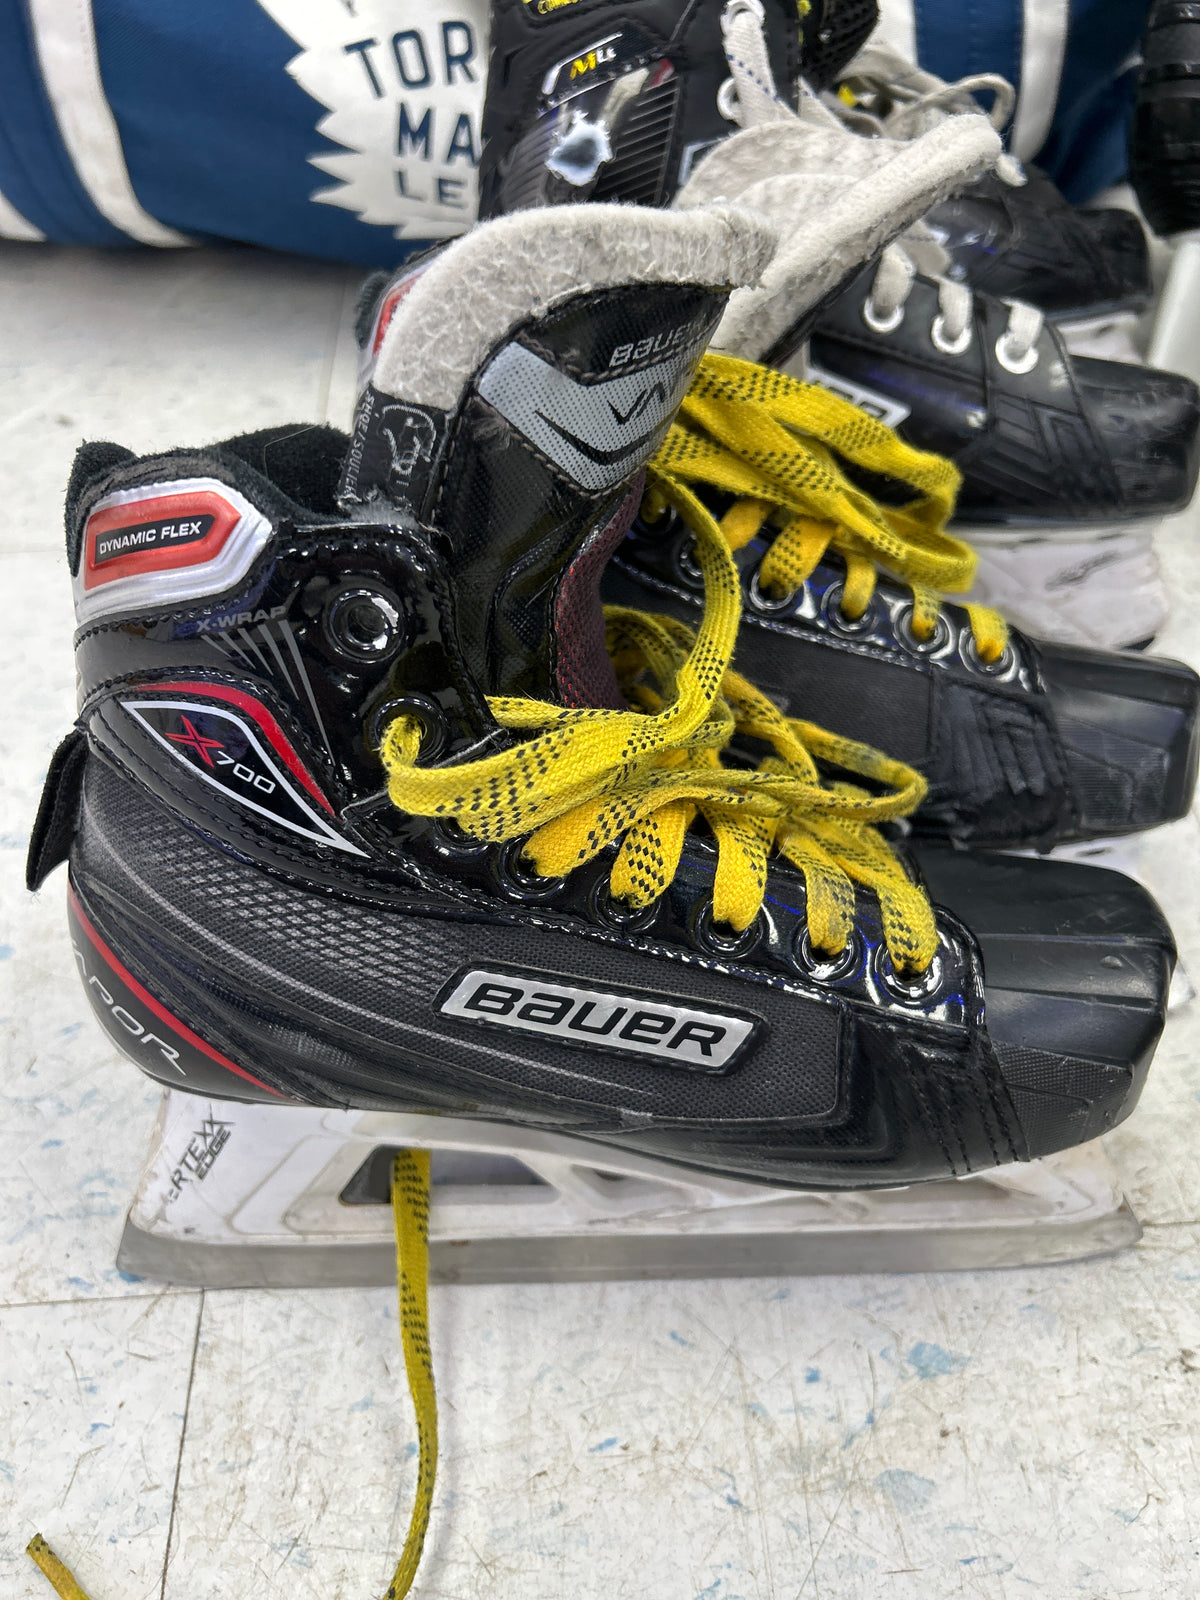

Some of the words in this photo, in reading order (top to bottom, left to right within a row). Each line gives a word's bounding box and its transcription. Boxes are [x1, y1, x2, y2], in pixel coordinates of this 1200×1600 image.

[99, 530, 156, 554] DYNAMIC
[161, 521, 202, 540] FLEX
[197, 605, 288, 633] X-WRAP
[463, 982, 727, 1057] BAUER
